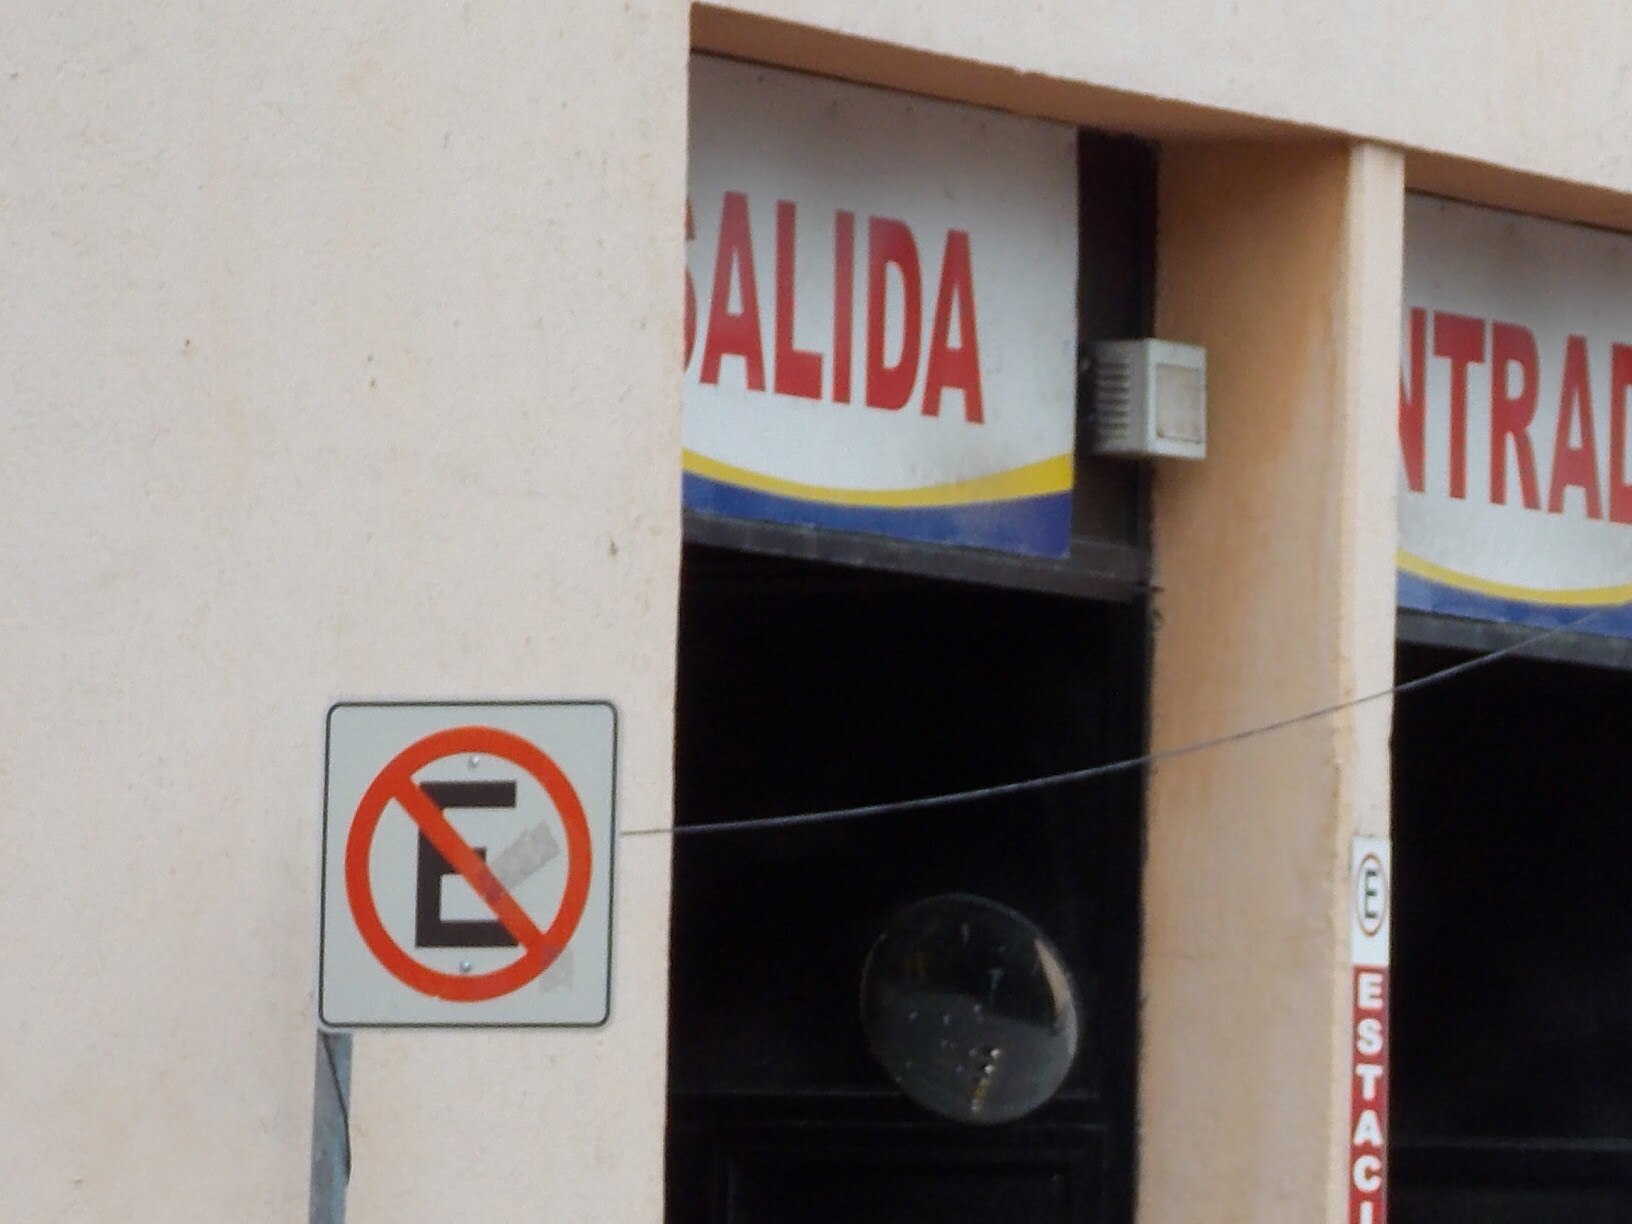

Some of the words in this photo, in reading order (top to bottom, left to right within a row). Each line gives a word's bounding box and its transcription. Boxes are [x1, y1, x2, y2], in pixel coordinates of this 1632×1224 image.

[683, 190, 985, 425] ALIDA
[415, 780, 518, 948] E
[1364, 868, 1378, 920] E
